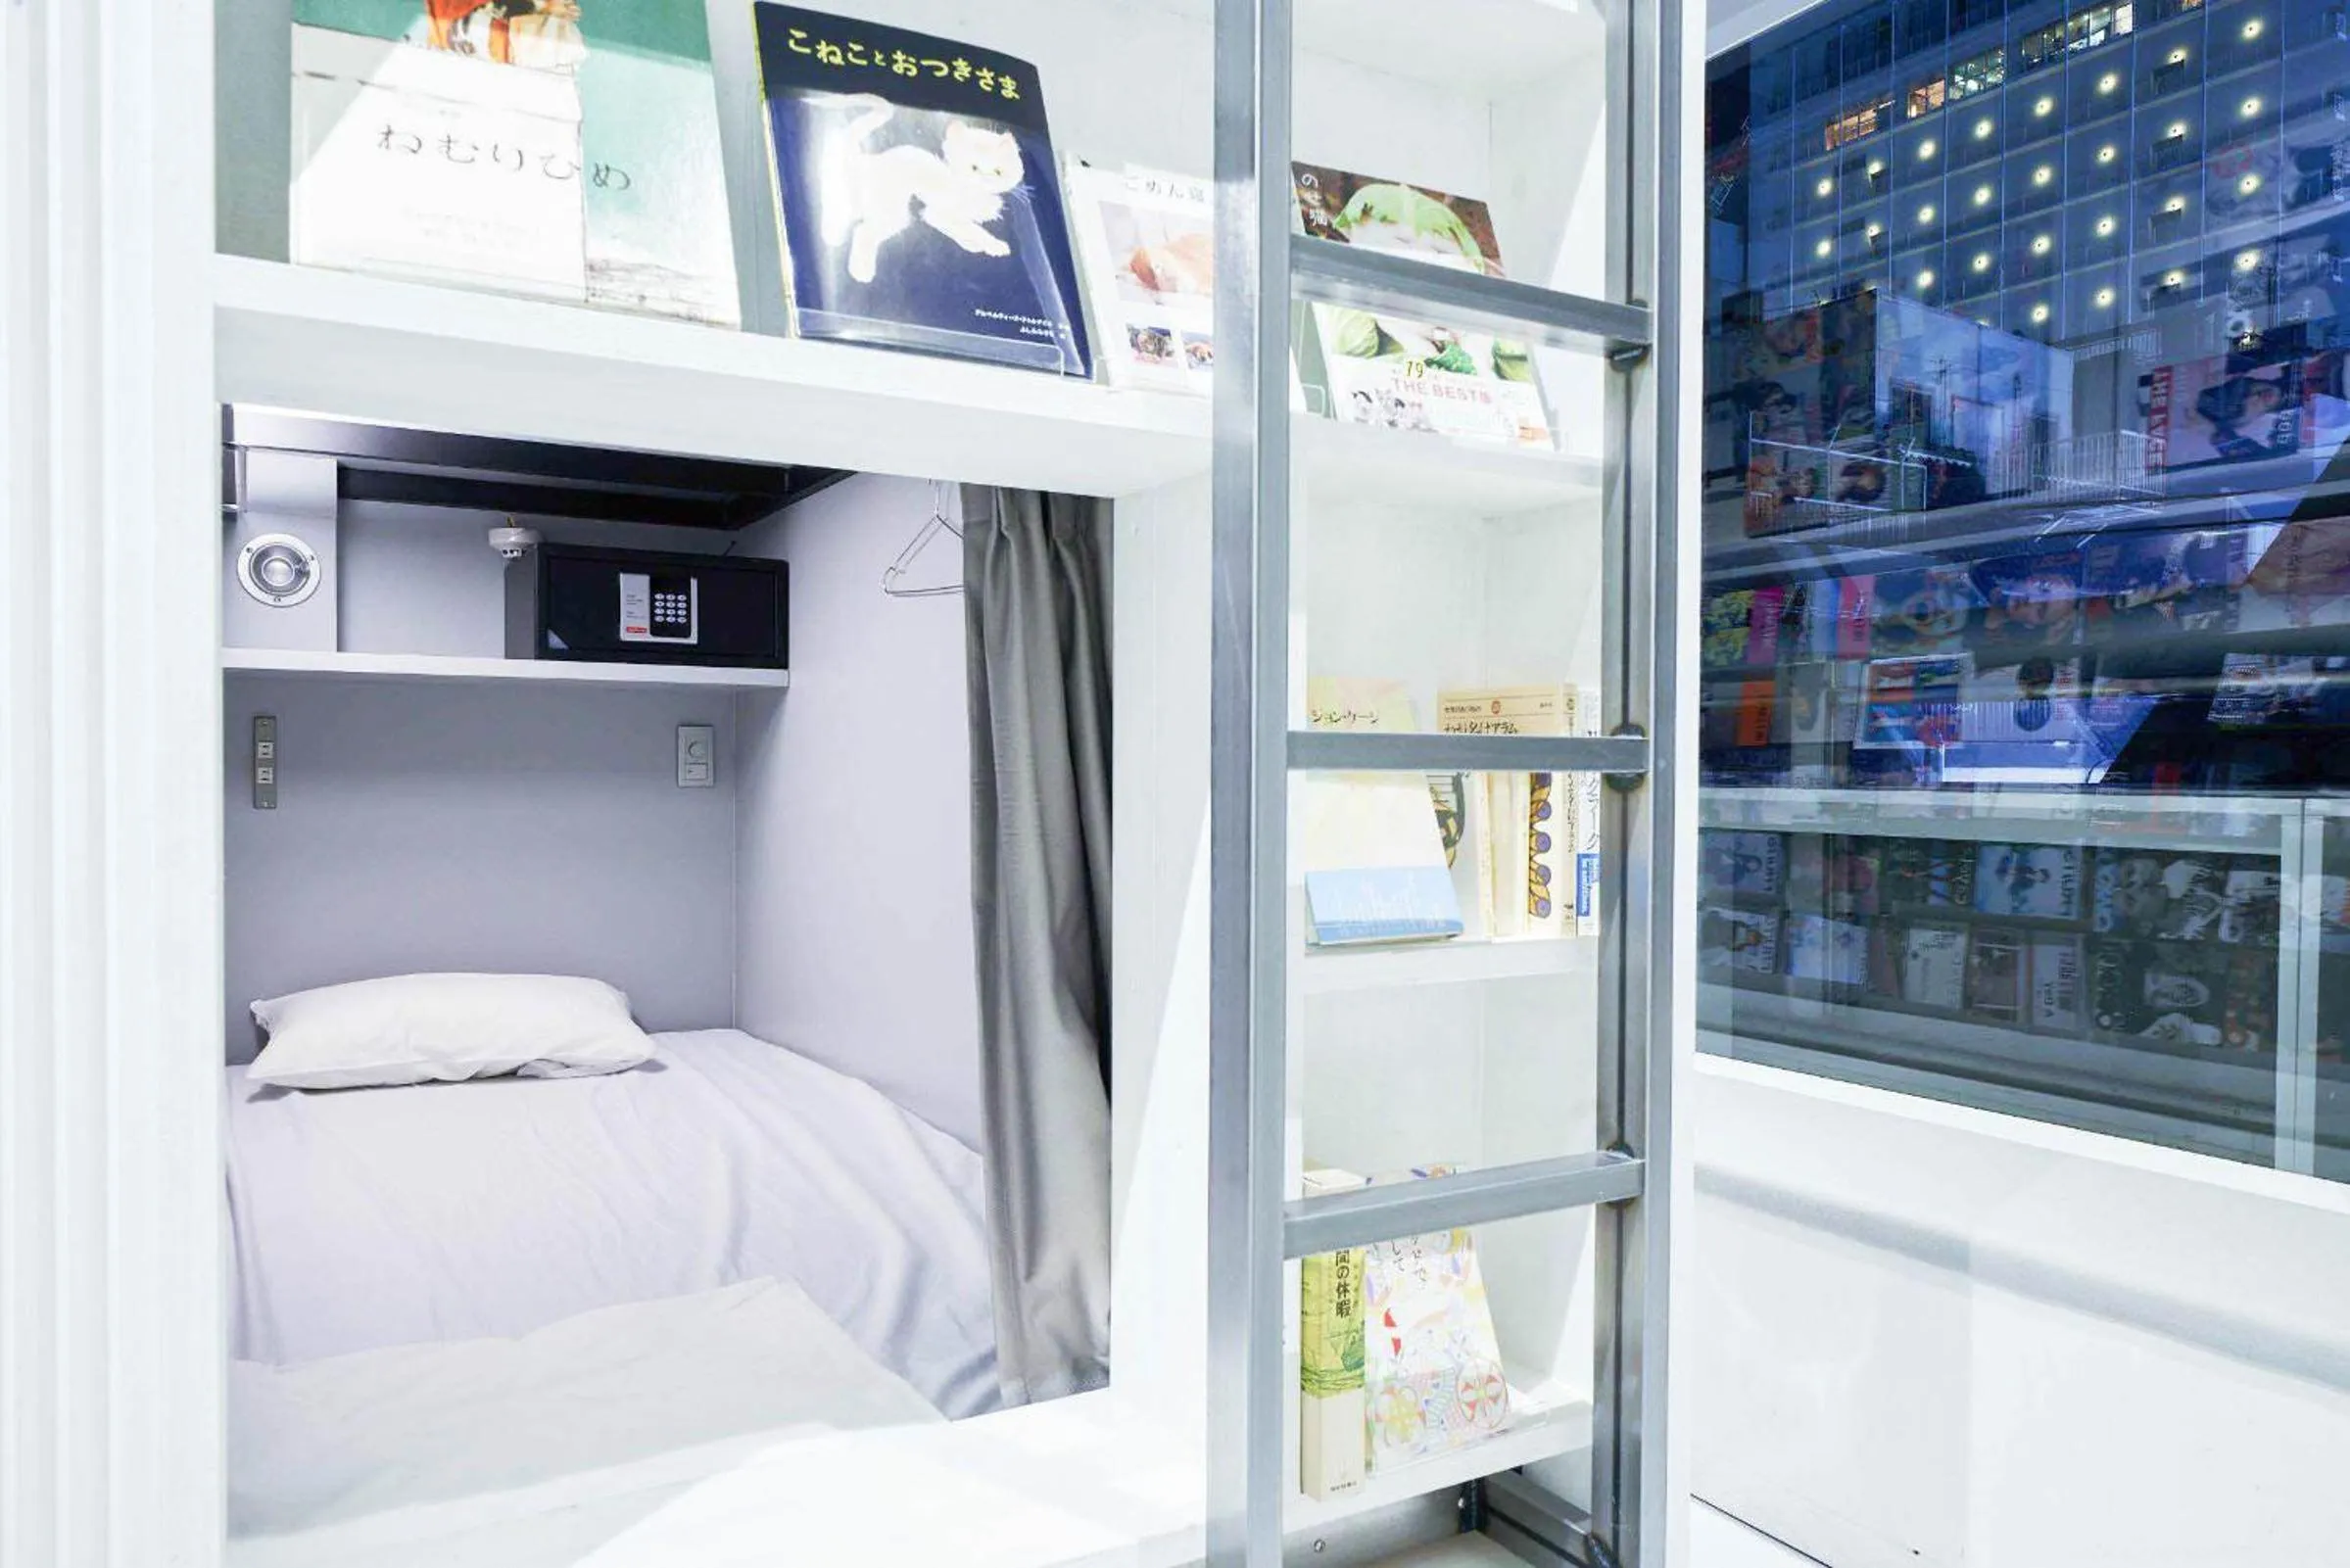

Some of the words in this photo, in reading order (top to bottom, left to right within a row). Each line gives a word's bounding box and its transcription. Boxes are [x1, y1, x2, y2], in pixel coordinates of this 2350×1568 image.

[787, 26, 1021, 100] こねことおつきさま
[377, 123, 631, 191] ねむりひめ
